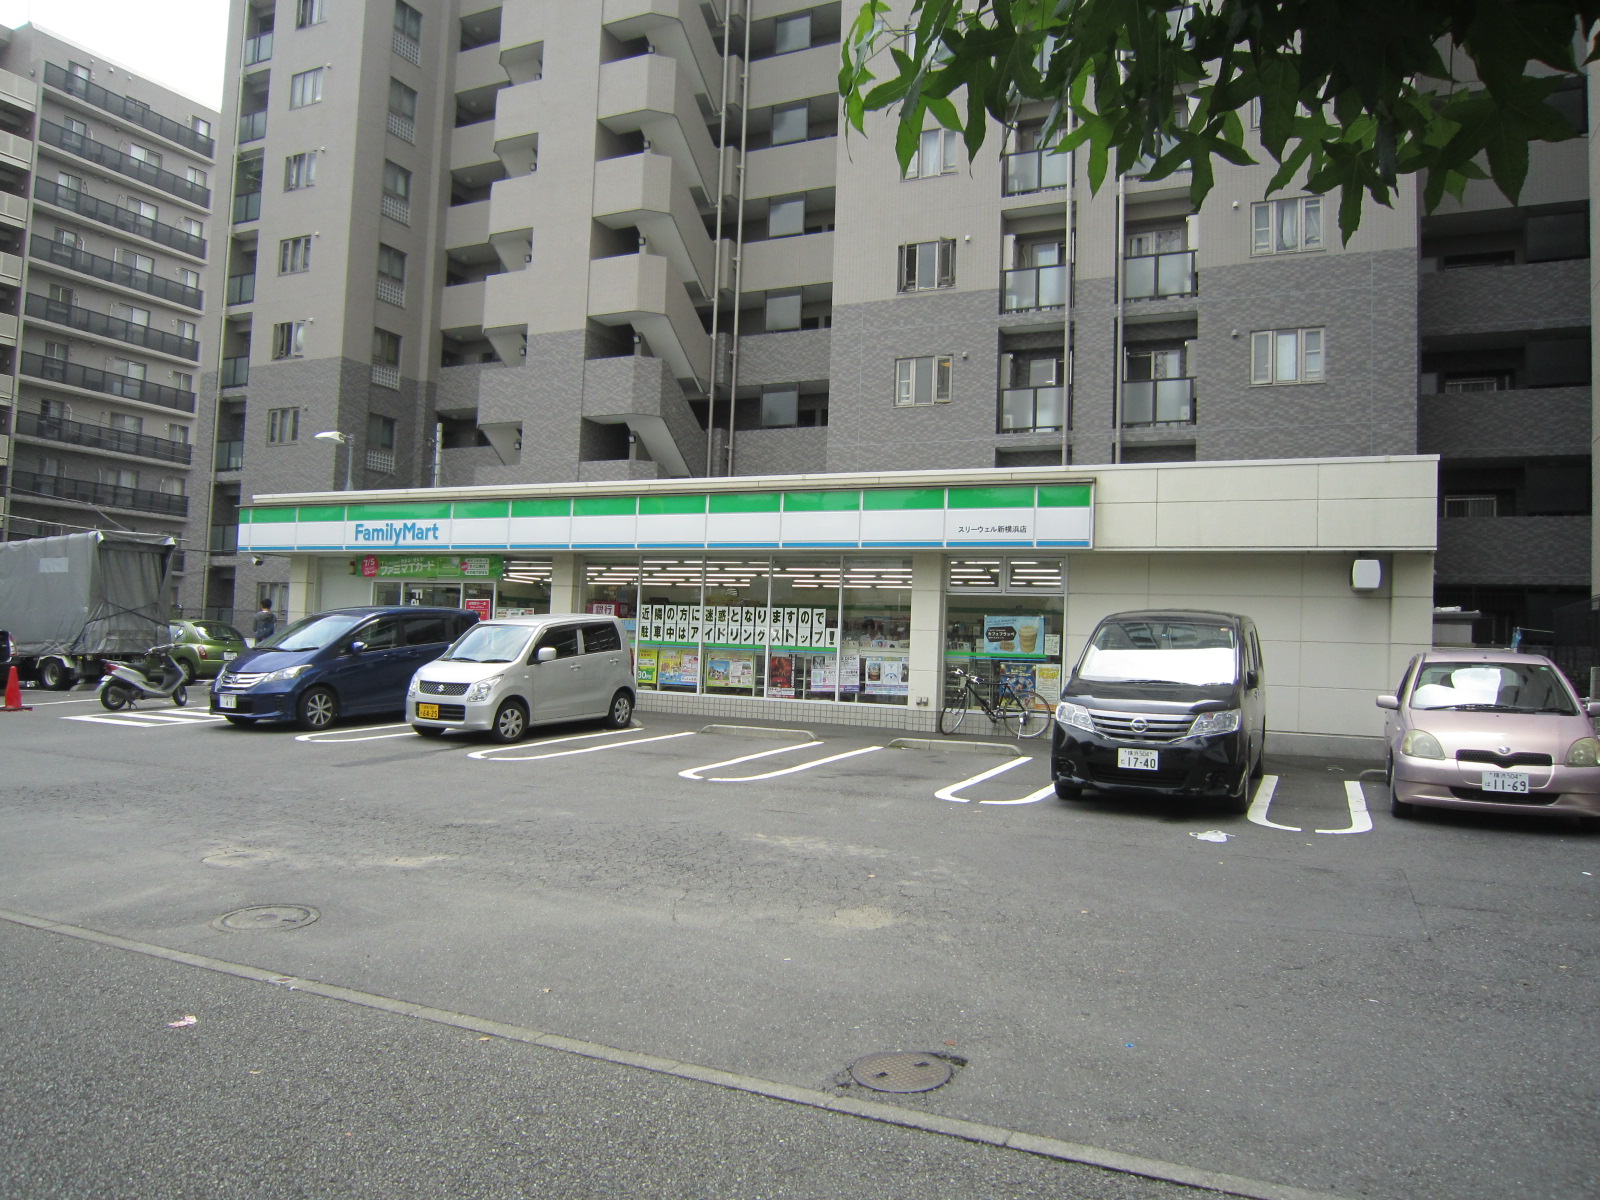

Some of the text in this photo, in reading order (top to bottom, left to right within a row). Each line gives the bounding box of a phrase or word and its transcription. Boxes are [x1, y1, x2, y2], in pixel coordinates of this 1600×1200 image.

[355, 522, 439, 545] FamilyMart
[958, 525, 1027, 533] スリーウェル新横浜店
[363, 558, 375, 567] 7/5
[595, 604, 612, 615] 銀行
[641, 606, 824, 625] 近隣の方に迷惑となりますので
[1128, 757, 1156, 769] 17-40
[1494, 779, 1526, 792] 11-69
